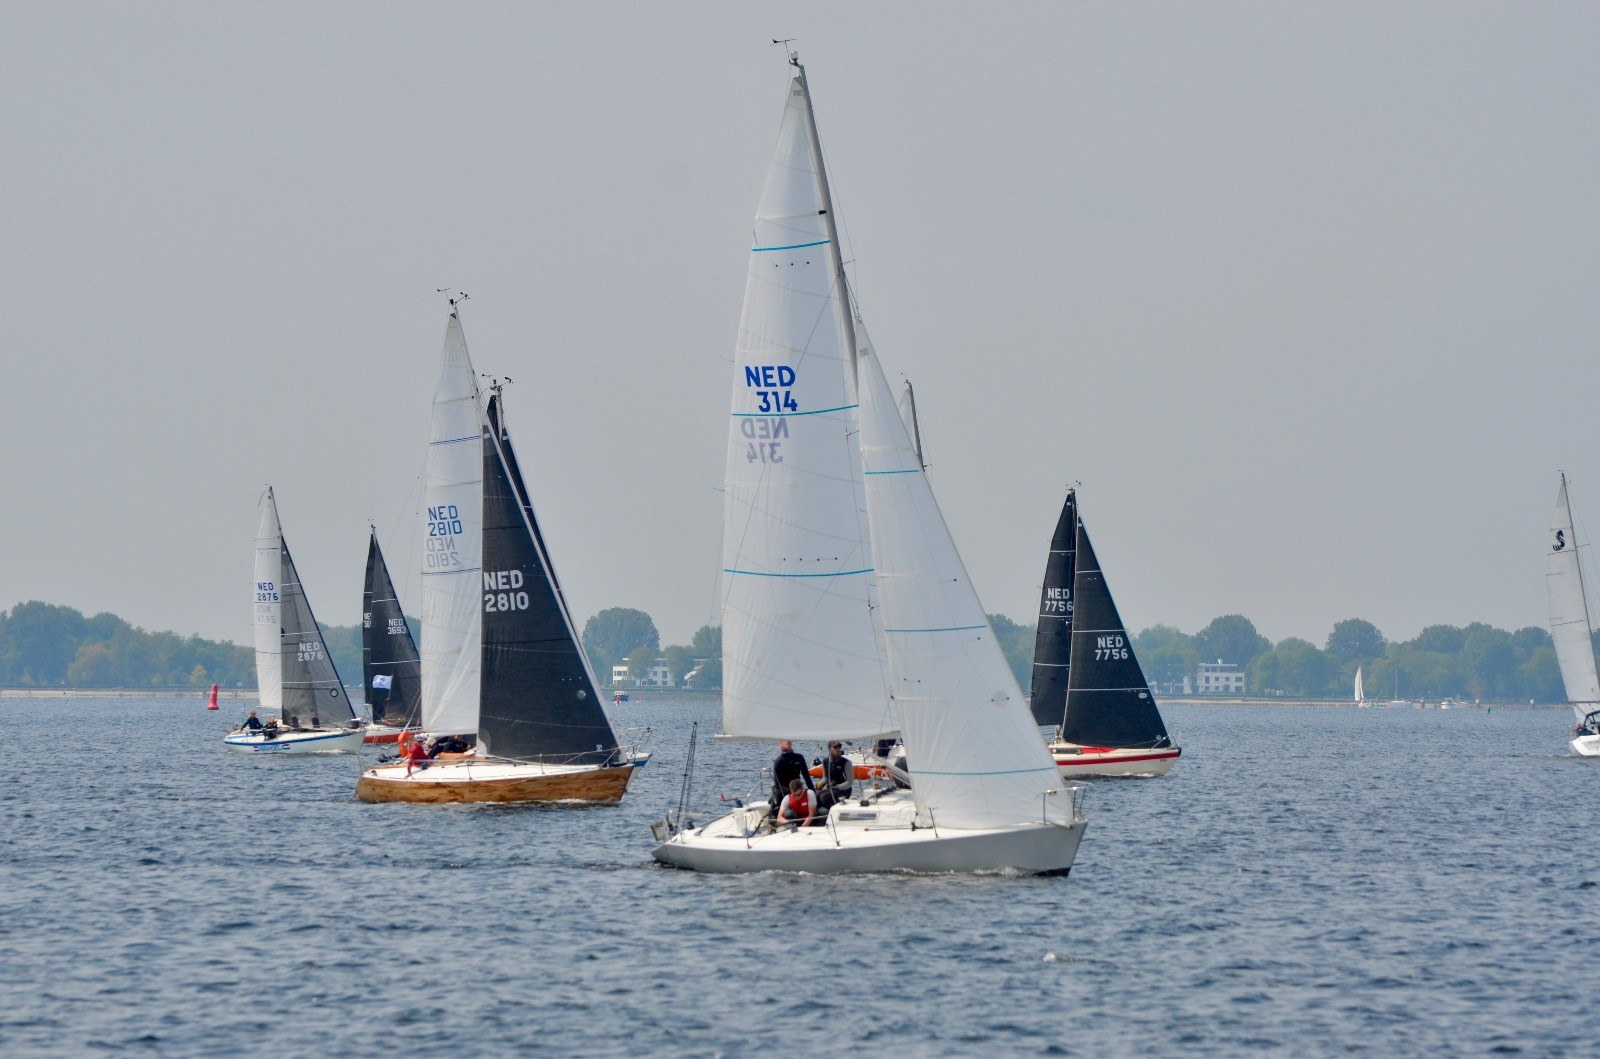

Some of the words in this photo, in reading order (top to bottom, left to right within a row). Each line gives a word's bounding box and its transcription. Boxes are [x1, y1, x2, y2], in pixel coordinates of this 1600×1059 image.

[744, 365, 796, 388] NED
[756, 390, 798, 413] 314
[427, 505, 459, 521] NED
[427, 520, 463, 537] 2810
[483, 569, 524, 591] NED
[257, 582, 274, 591] NED
[257, 592, 279, 601] 2876
[1047, 587, 1071, 600] NED
[484, 591, 530, 613] 2810
[1044, 600, 1073, 612] 7756
[363, 612, 372, 620] NE
[388, 618, 404, 627] NED
[387, 626, 407, 635] 3693
[299, 641, 320, 652] NED
[1097, 636, 1124, 648] NED
[297, 651, 324, 662] 2876
[1094, 648, 1129, 661] 7756
